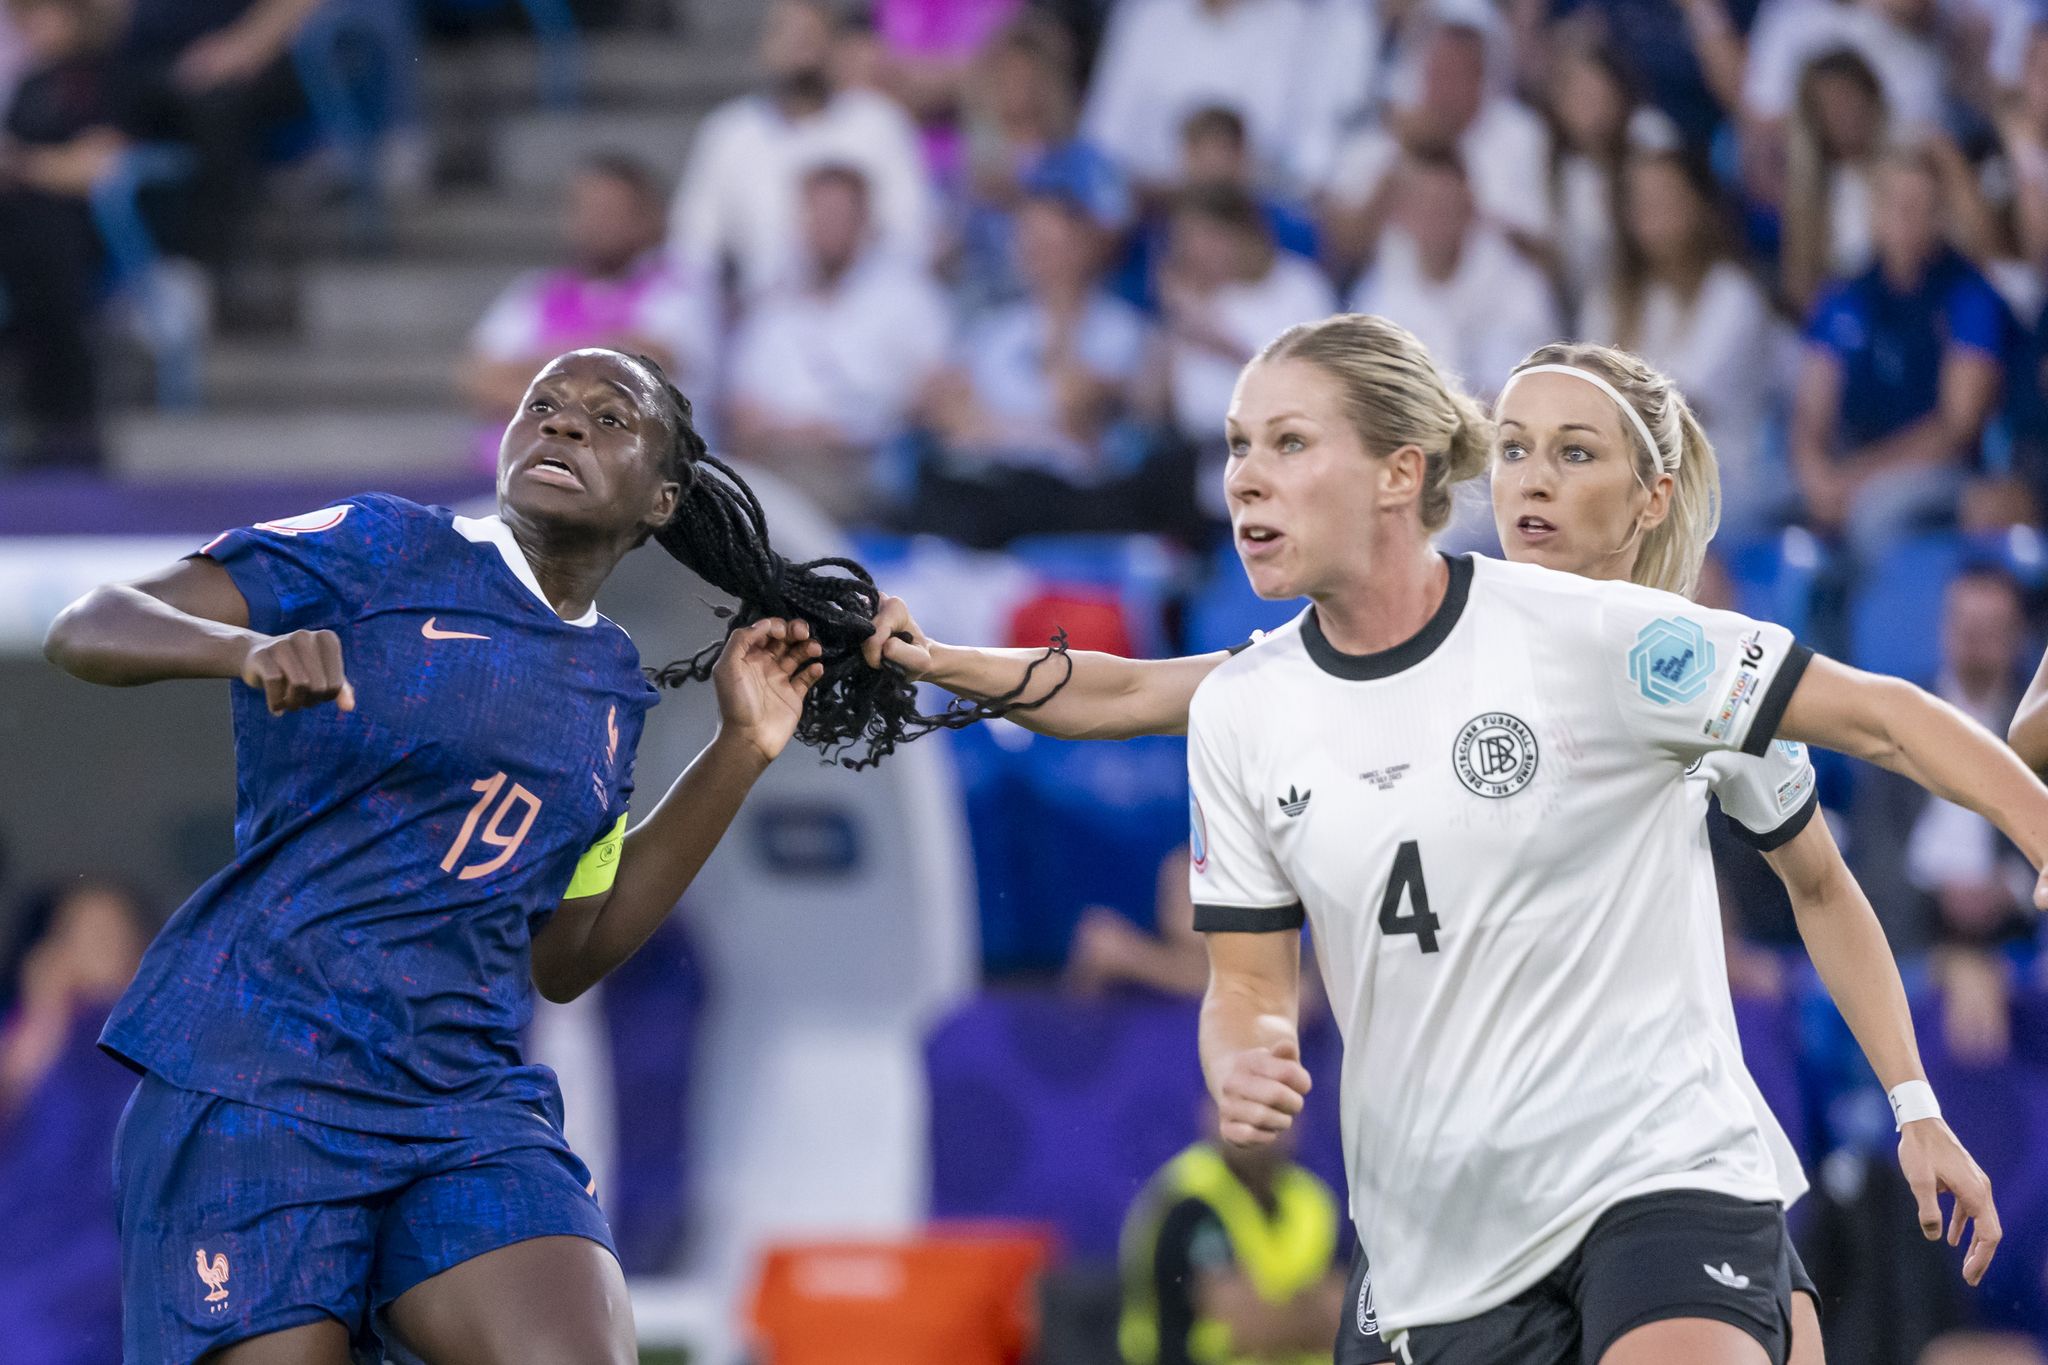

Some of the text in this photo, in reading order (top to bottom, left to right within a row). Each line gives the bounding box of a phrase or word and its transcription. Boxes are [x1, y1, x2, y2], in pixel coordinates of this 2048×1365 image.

[1458, 724, 1482, 789] DEUTSCHER
[440, 771, 543, 880] 19
[1378, 839, 1441, 954] 4
